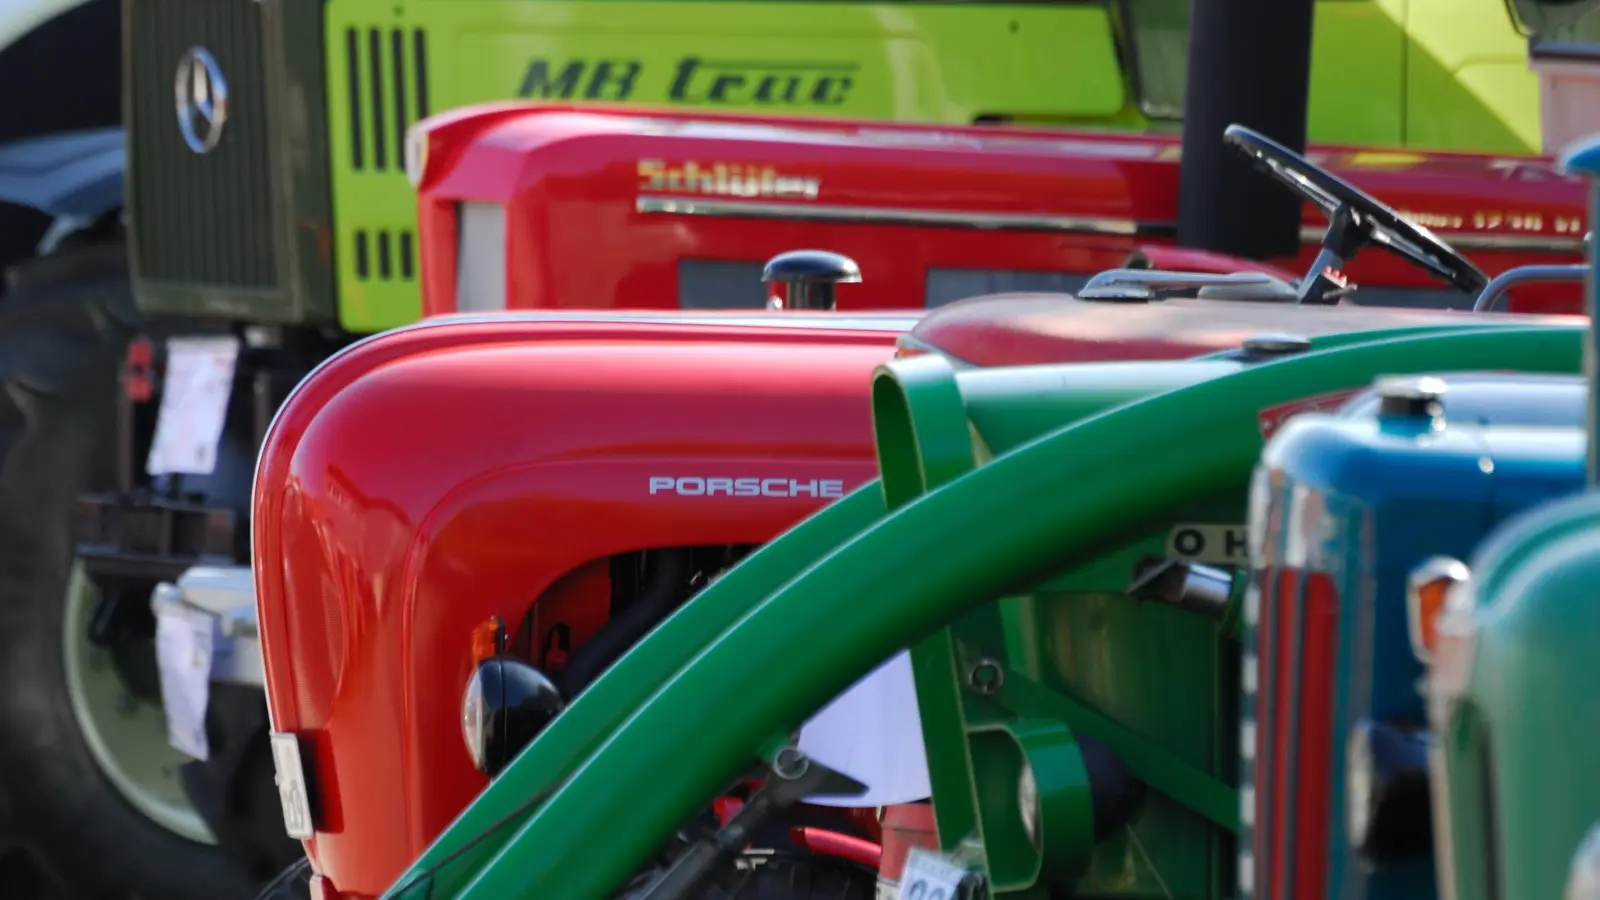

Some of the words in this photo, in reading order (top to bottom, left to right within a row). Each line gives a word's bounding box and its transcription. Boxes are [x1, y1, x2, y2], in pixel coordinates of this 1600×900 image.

[518, 56, 643, 100] MB
[668, 55, 855, 105] trac
[637, 158, 820, 197] Schlüter
[648, 475, 844, 498] PORSCHE
